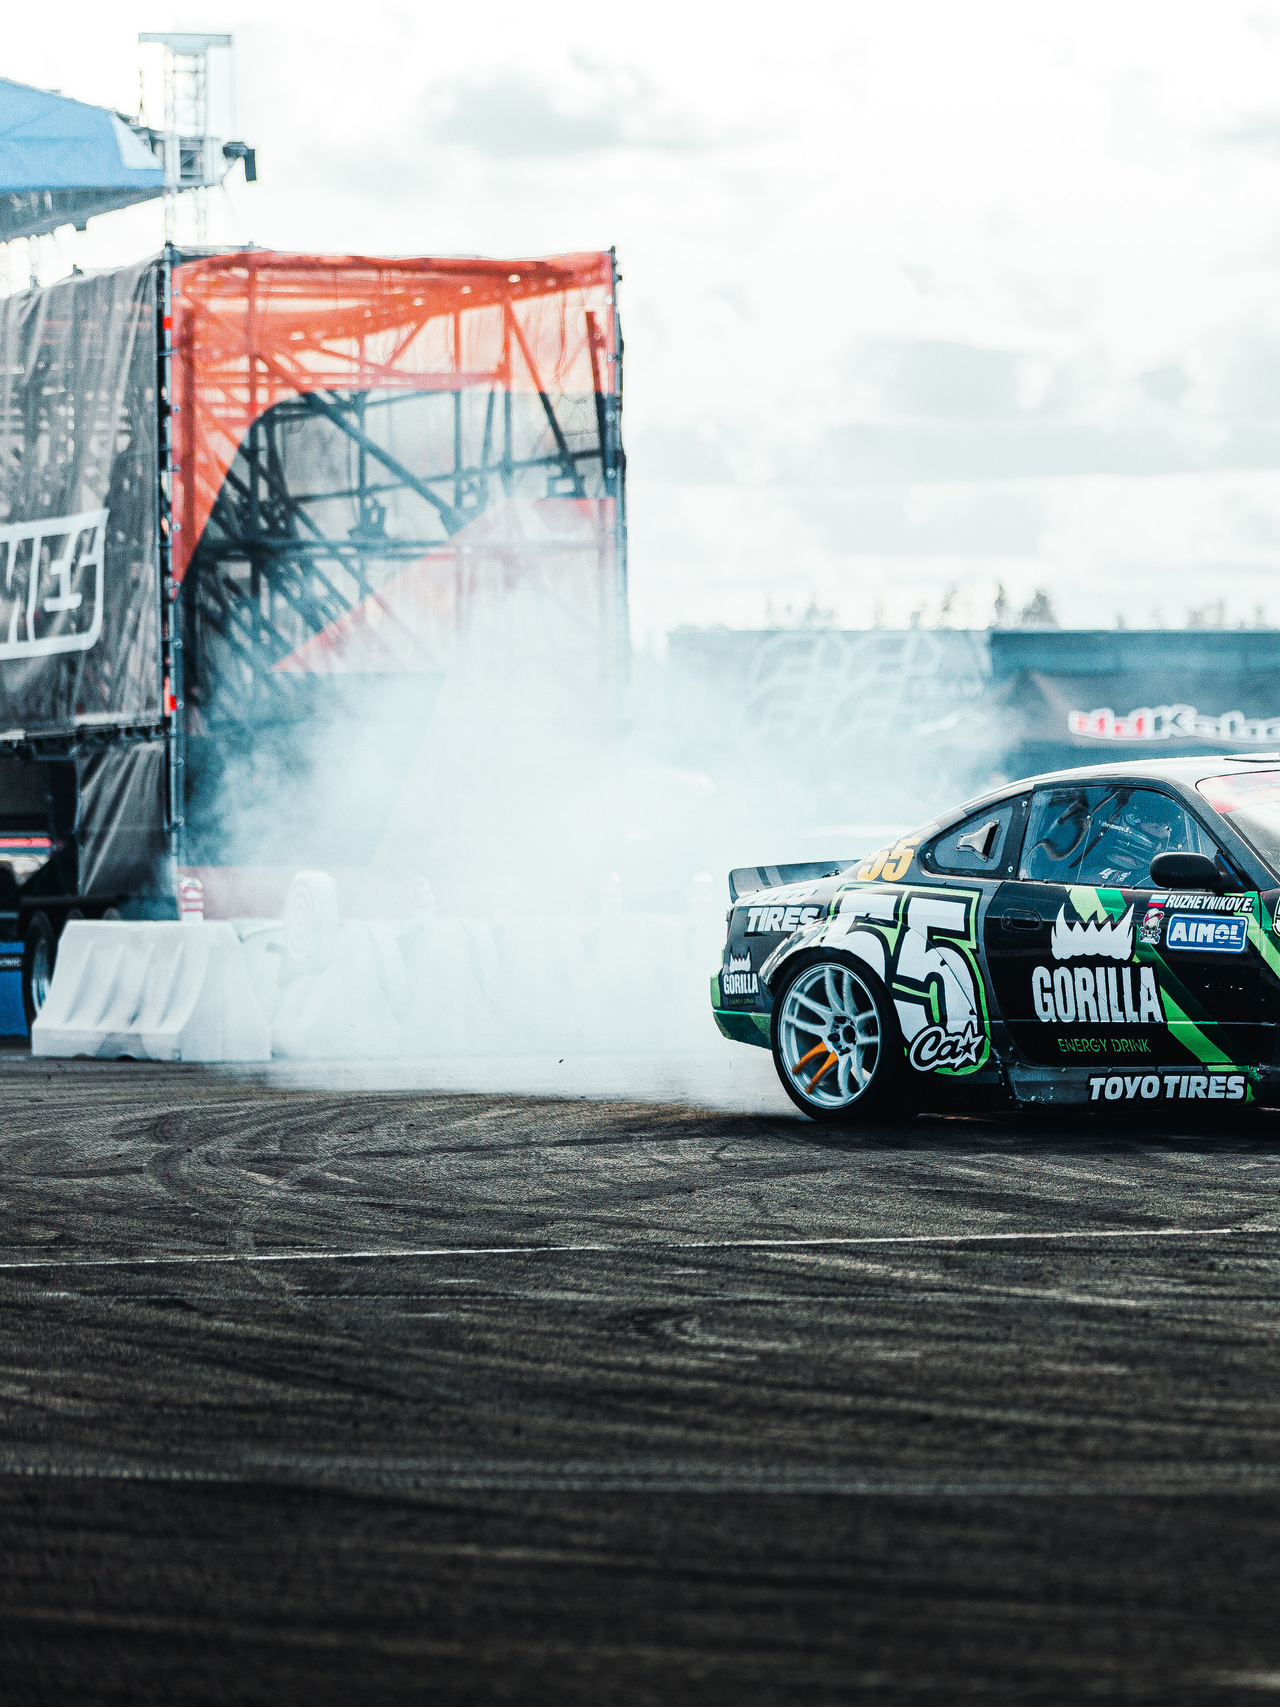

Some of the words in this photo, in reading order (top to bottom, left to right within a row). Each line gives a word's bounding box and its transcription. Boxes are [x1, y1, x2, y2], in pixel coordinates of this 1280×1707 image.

[857, 837, 921, 882] 55
[746, 906, 820, 932] TIRES
[1169, 922, 1242, 944] AIMOL
[723, 973, 759, 995] GORILLA
[1032, 965, 1164, 1023] GORILLA
[1057, 1038, 1107, 1052] ENERGY
[1111, 1038, 1152, 1053] DRINK
[1089, 1075, 1161, 1100] TOYO
[1163, 1075, 1245, 1099] TIRES
